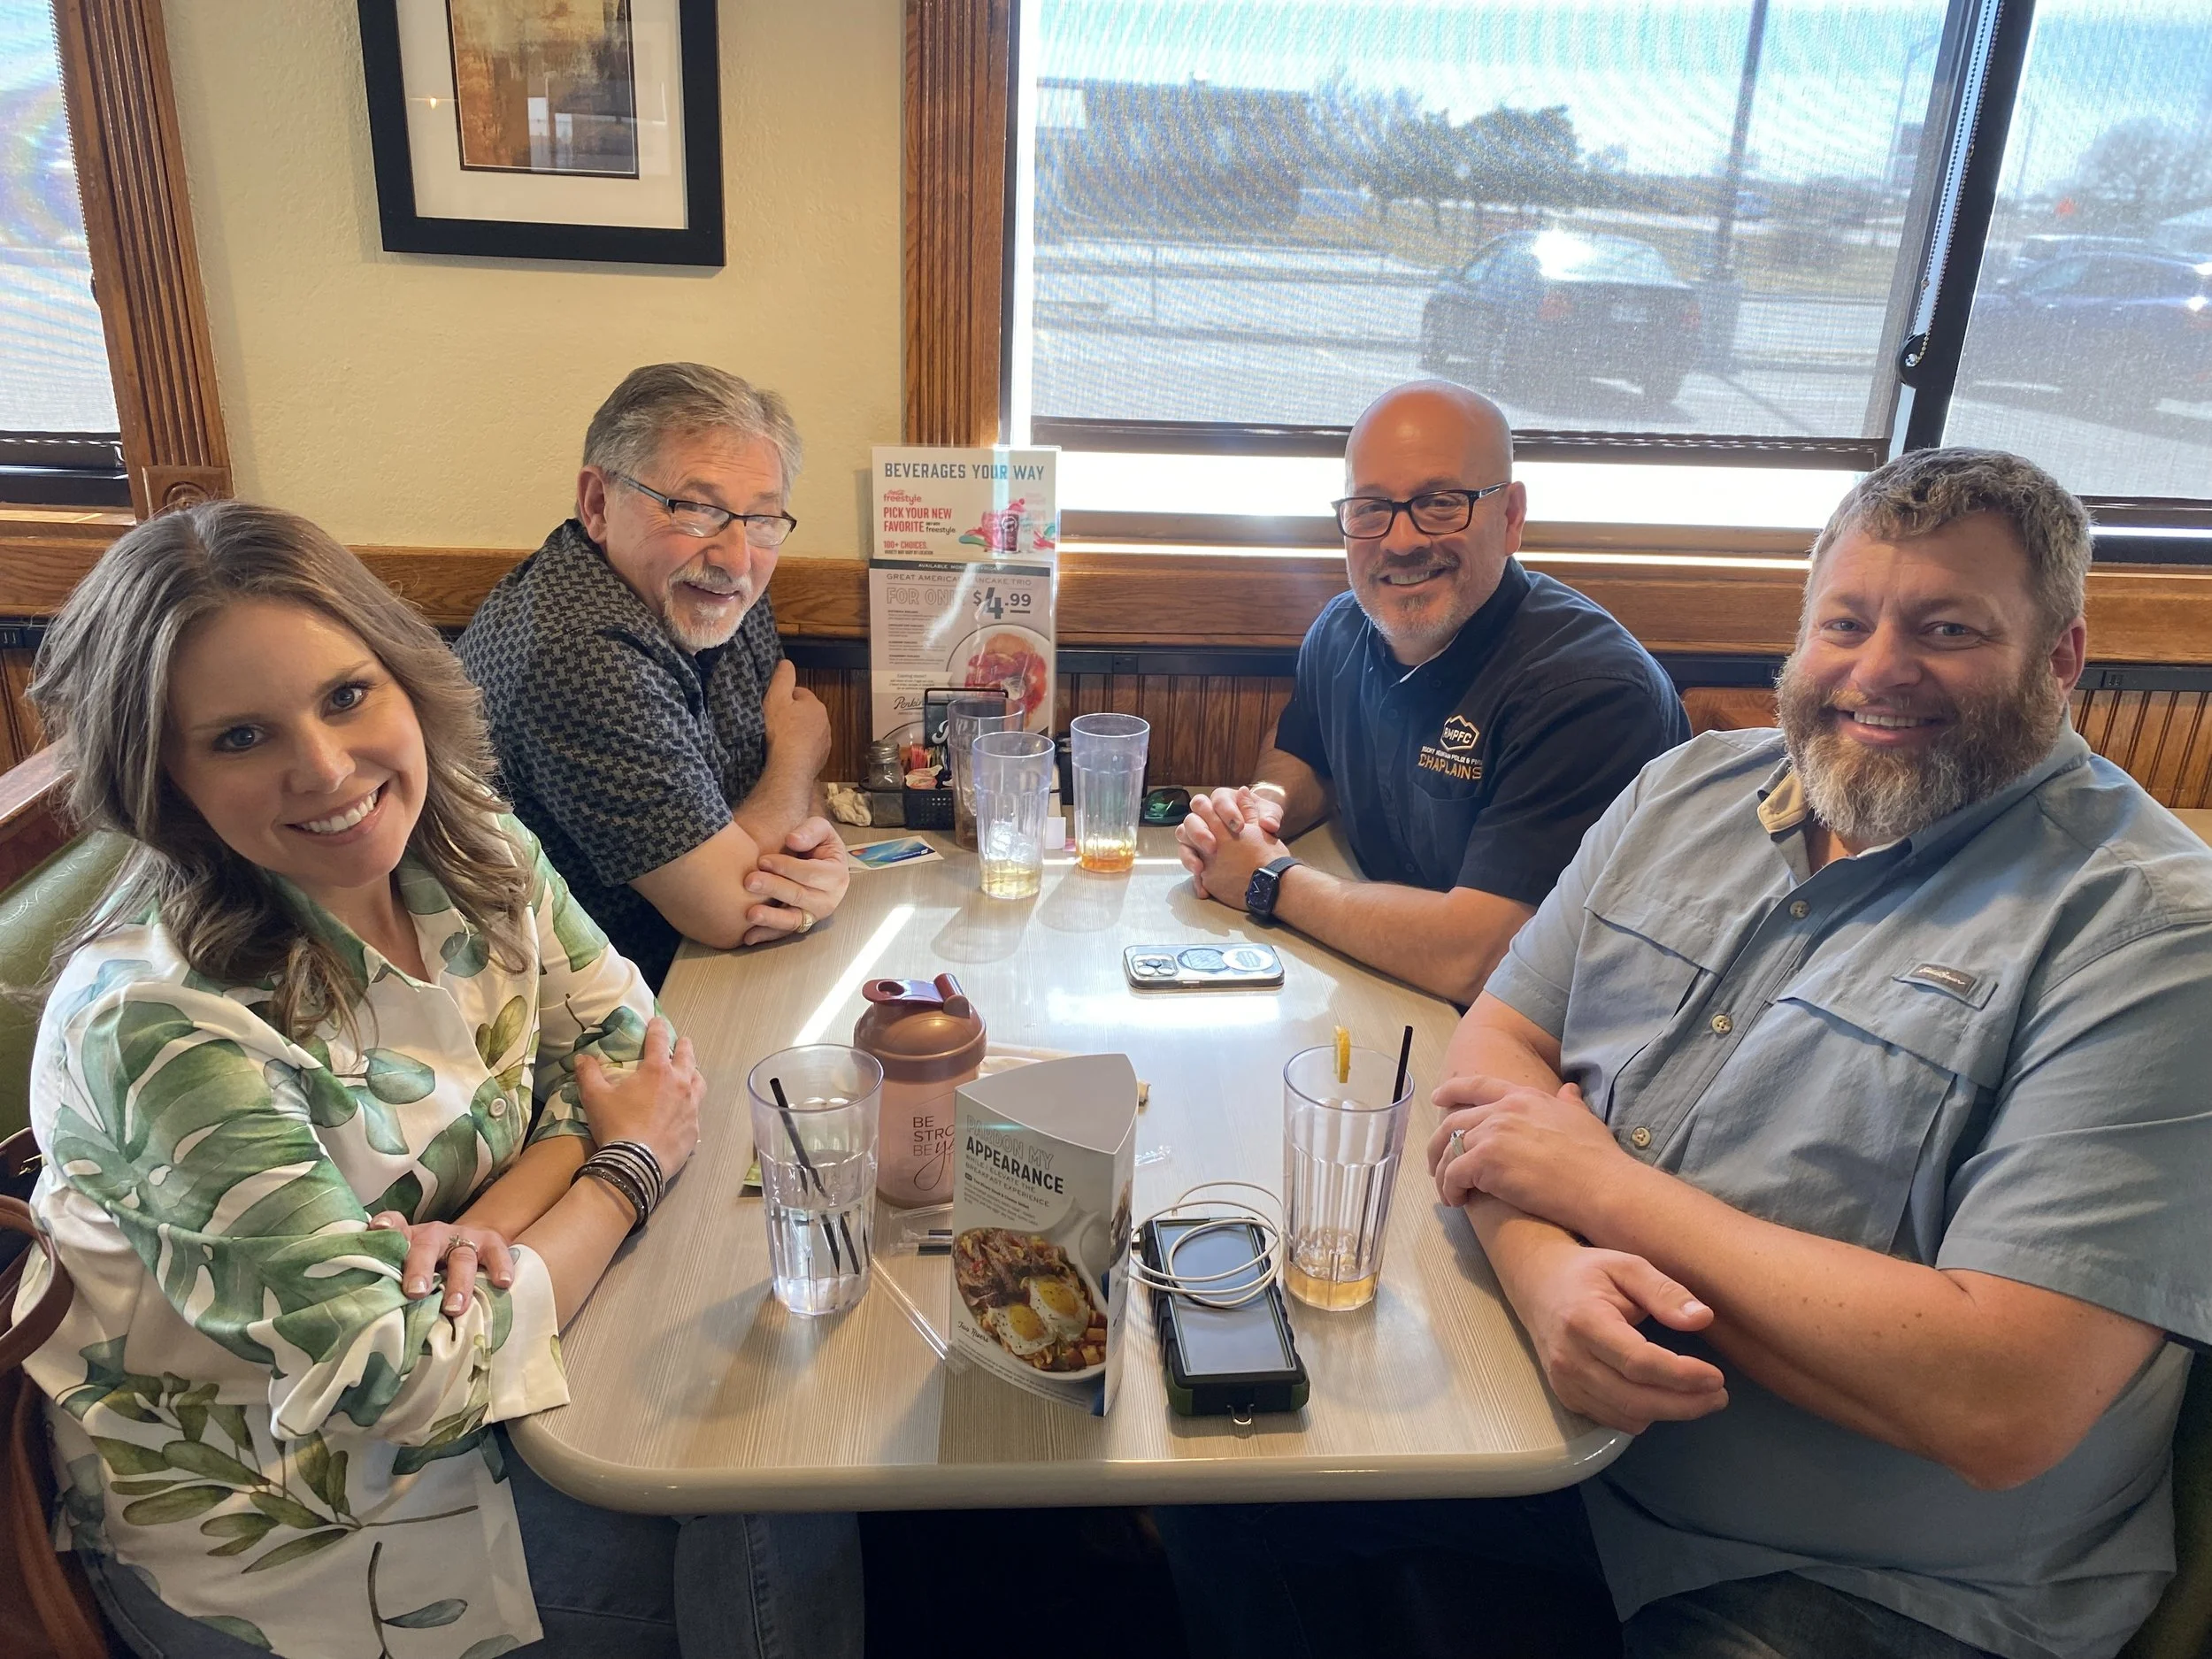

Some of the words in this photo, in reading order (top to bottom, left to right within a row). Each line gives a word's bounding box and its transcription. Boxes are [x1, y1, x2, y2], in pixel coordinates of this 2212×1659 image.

[885, 463, 966, 479] BEVERAGES
[972, 465, 1008, 480] YOUR
[1013, 465, 1044, 480] WAY
[884, 494, 922, 505] freestyle
[884, 506, 903, 518] PICK
[906, 507, 929, 518] YOUR
[932, 508, 952, 519] NEW
[884, 520, 925, 533] FAVORITE
[926, 526, 956, 535] freestyle
[887, 587, 919, 605] FOR
[1417, 753, 1483, 780] CHAPLAINS
[913, 1115, 934, 1128] BE
[913, 1143, 933, 1156] BE
[966, 1114, 1024, 1159] PARDON
[1028, 1145, 1054, 1171] MY
[966, 1135, 1064, 1194] APPEARANCE
[965, 1154, 985, 1169] WHILE
[989, 1165, 1020, 1187] ELEVATE
[1022, 1183, 1036, 1194] THE
[965, 1162, 1002, 1187] BREAKFAST
[1003, 1183, 1050, 1208] EXPERIENCE
[971, 1327, 988, 1343] Rivers
